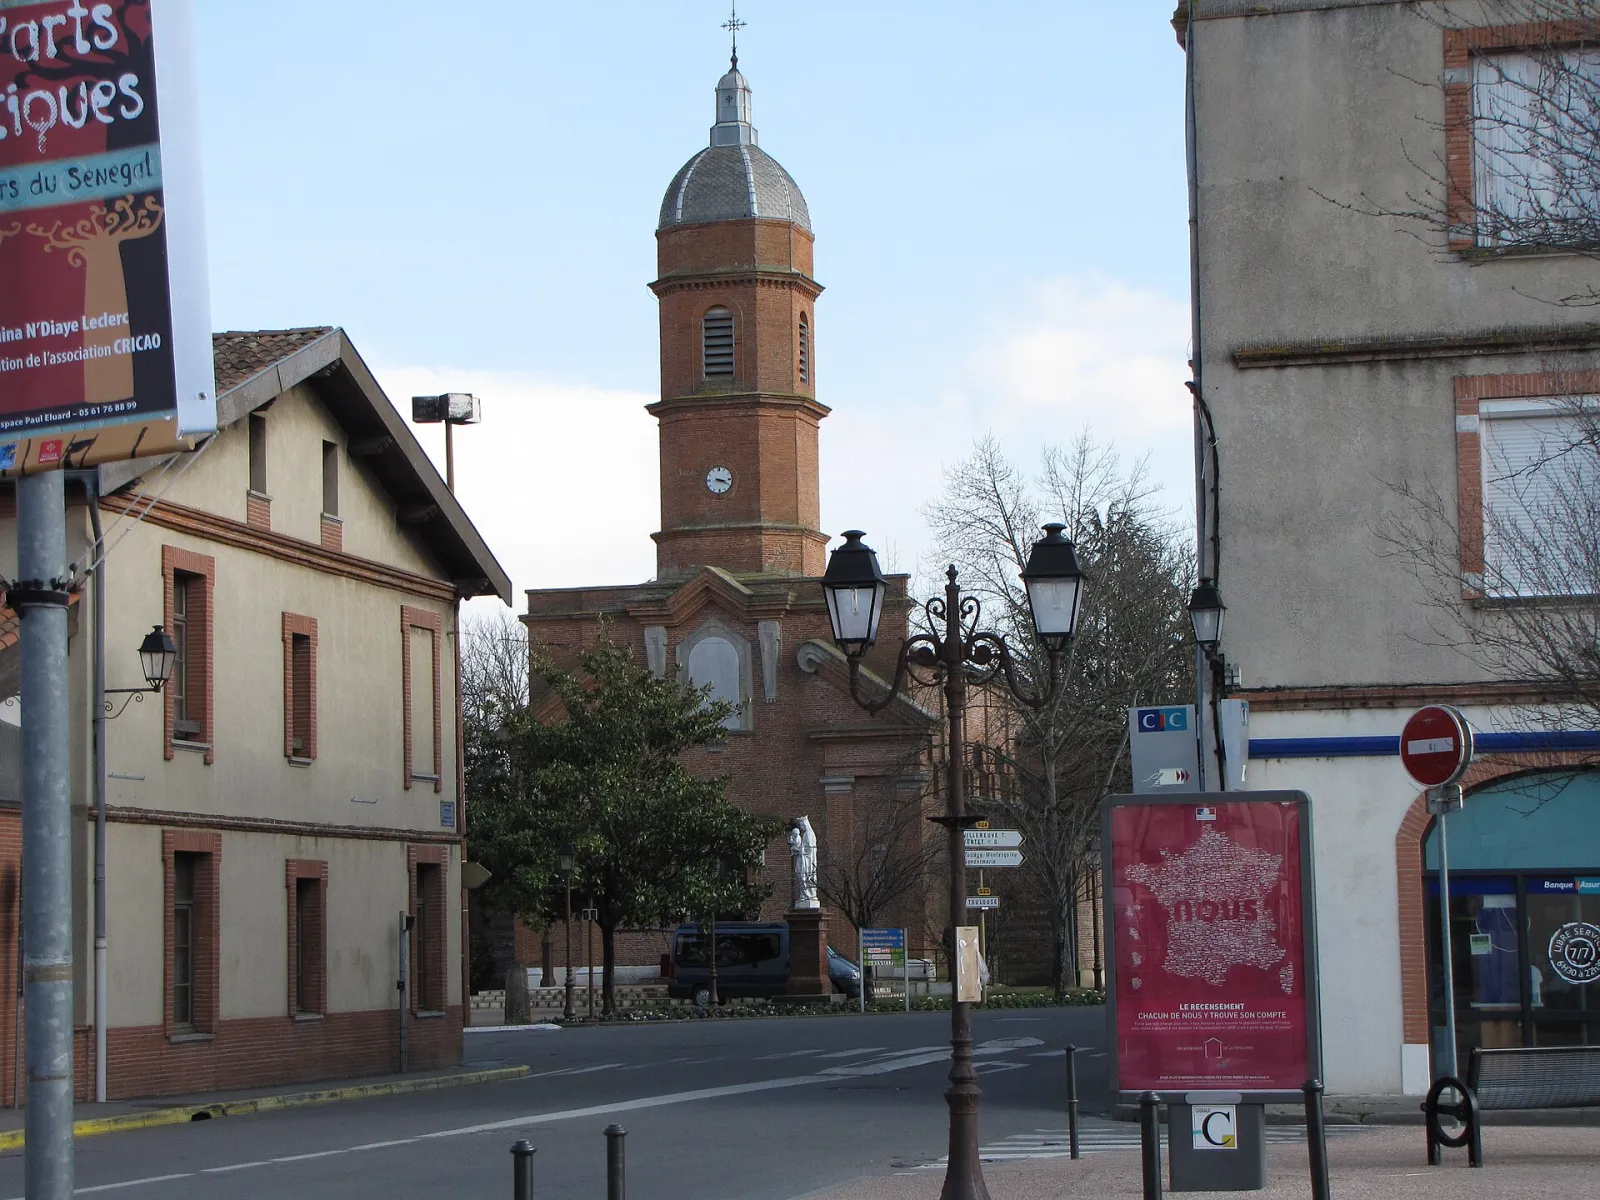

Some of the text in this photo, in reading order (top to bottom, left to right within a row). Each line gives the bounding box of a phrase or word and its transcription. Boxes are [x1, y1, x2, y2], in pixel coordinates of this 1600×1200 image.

[30, 172, 57, 195] du
[26, 319, 79, 338] N'Diaye
[82, 312, 129, 331] Leclerc
[26, 354, 41, 367] de
[44, 345, 112, 365] l'association
[114, 333, 162, 354] CRICAO
[0, 419, 23, 430] space
[25, 415, 43, 425] Paul
[45, 411, 71, 421] Eluard
[79, 408, 89, 417] 05
[91, 406, 100, 415] 61
[103, 404, 113, 413] 76
[115, 403, 125, 412] 88
[127, 401, 137, 410] 99
[1544, 881, 1574, 890] Banque
[1554, 930, 1572, 953] LIBRE
[1569, 947, 1589, 960] 7/7
[1179, 1003, 1245, 1011] LE RECENSEMENT
[1202, 1111, 1231, 1146] C
